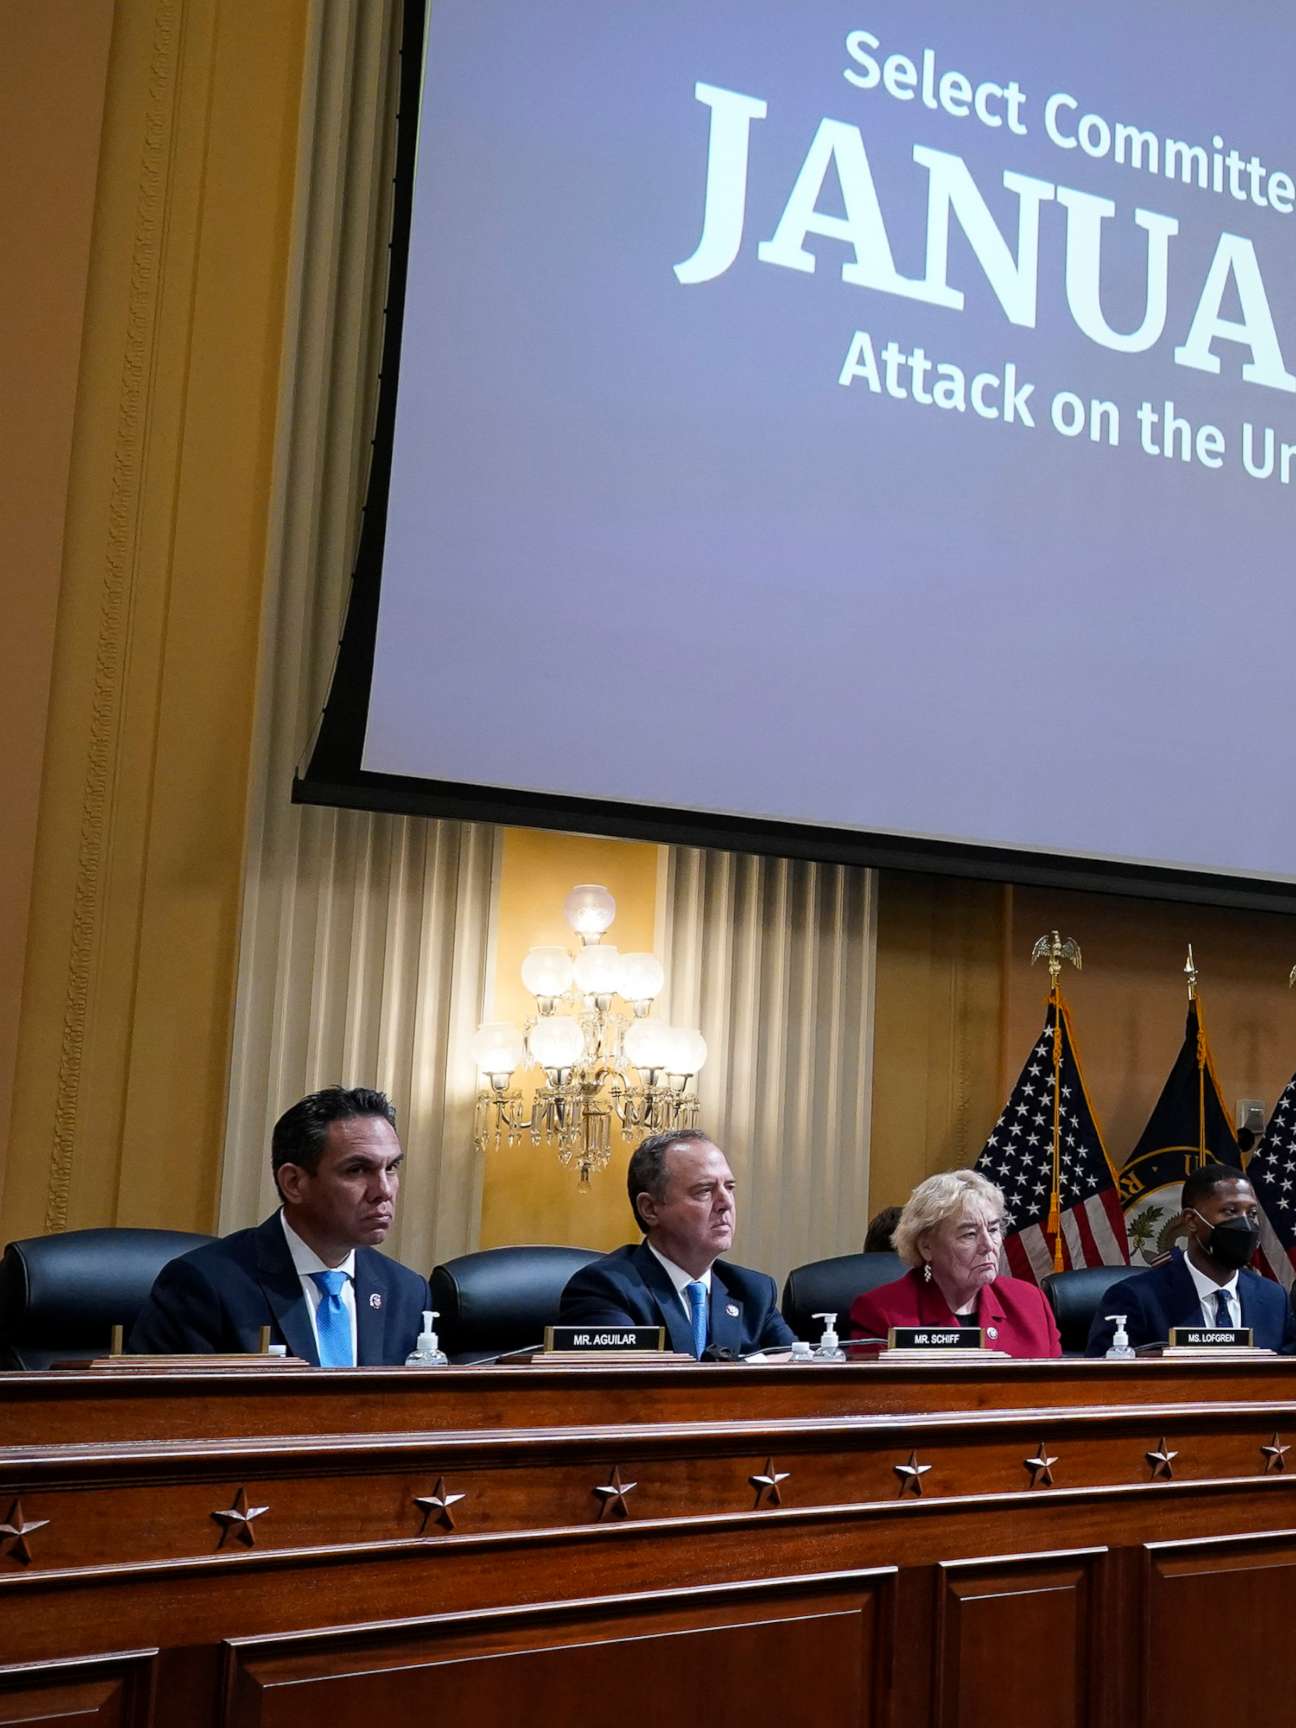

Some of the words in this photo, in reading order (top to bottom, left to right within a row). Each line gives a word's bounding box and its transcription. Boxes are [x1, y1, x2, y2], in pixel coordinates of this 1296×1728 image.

[843, 30, 1027, 135] Select
[838, 331, 1036, 428] Attack
[1051, 391, 1120, 446] on
[1136, 402, 1226, 469] the
[573, 1335, 592, 1346] MR.
[593, 1333, 637, 1345] AGUILAR
[914, 1334, 930, 1345] MR.
[931, 1333, 961, 1344] SCHIFF
[1187, 1333, 1200, 1343] MS.
[1202, 1333, 1236, 1342] LOFGREN
